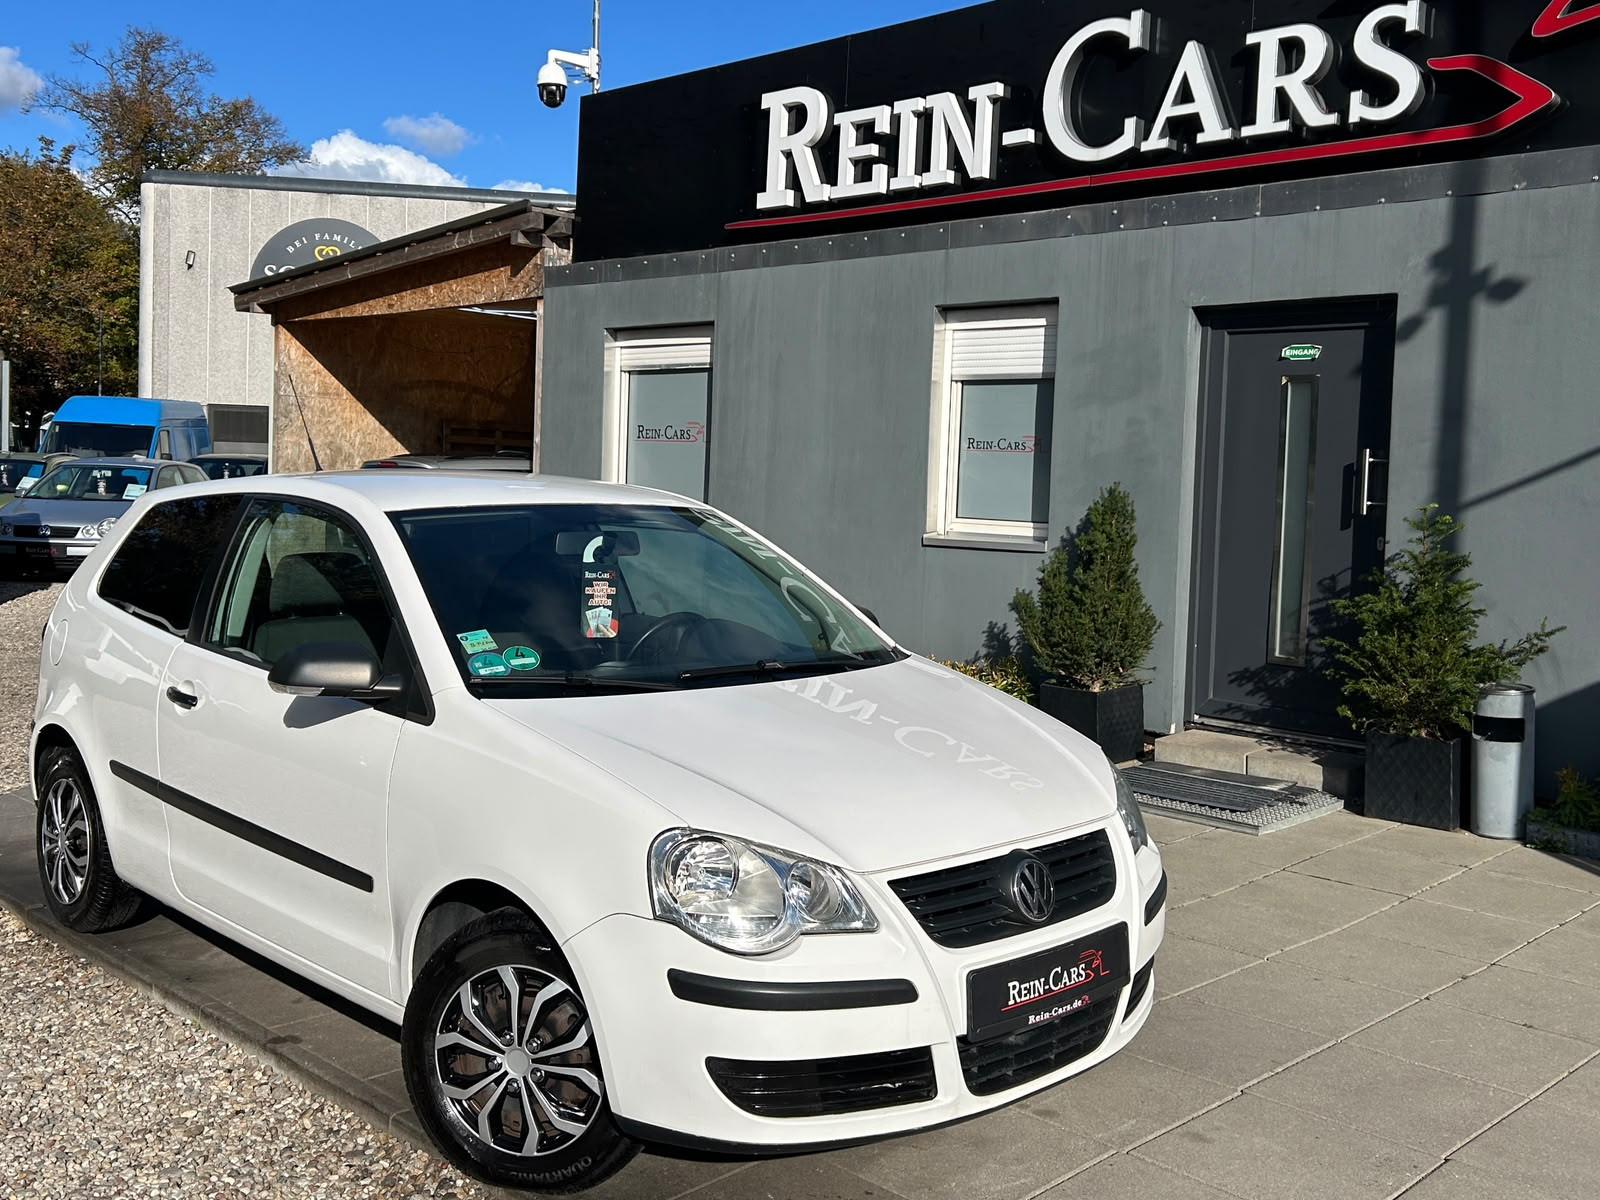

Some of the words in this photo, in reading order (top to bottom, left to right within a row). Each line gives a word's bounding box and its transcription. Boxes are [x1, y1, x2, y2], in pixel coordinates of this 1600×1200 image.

[755, 2, 1428, 211] REIN-CARS
[286, 236, 308, 254] BEI
[1285, 348, 1319, 356] EINGANG
[636, 424, 691, 440] REIN-CARS
[967, 437, 1027, 451] REIN-CARS
[515, 647, 526, 659] 4
[1007, 963, 1087, 1006] REIN-CARS
[1028, 1000, 1083, 1025] Rein-Cars.de
